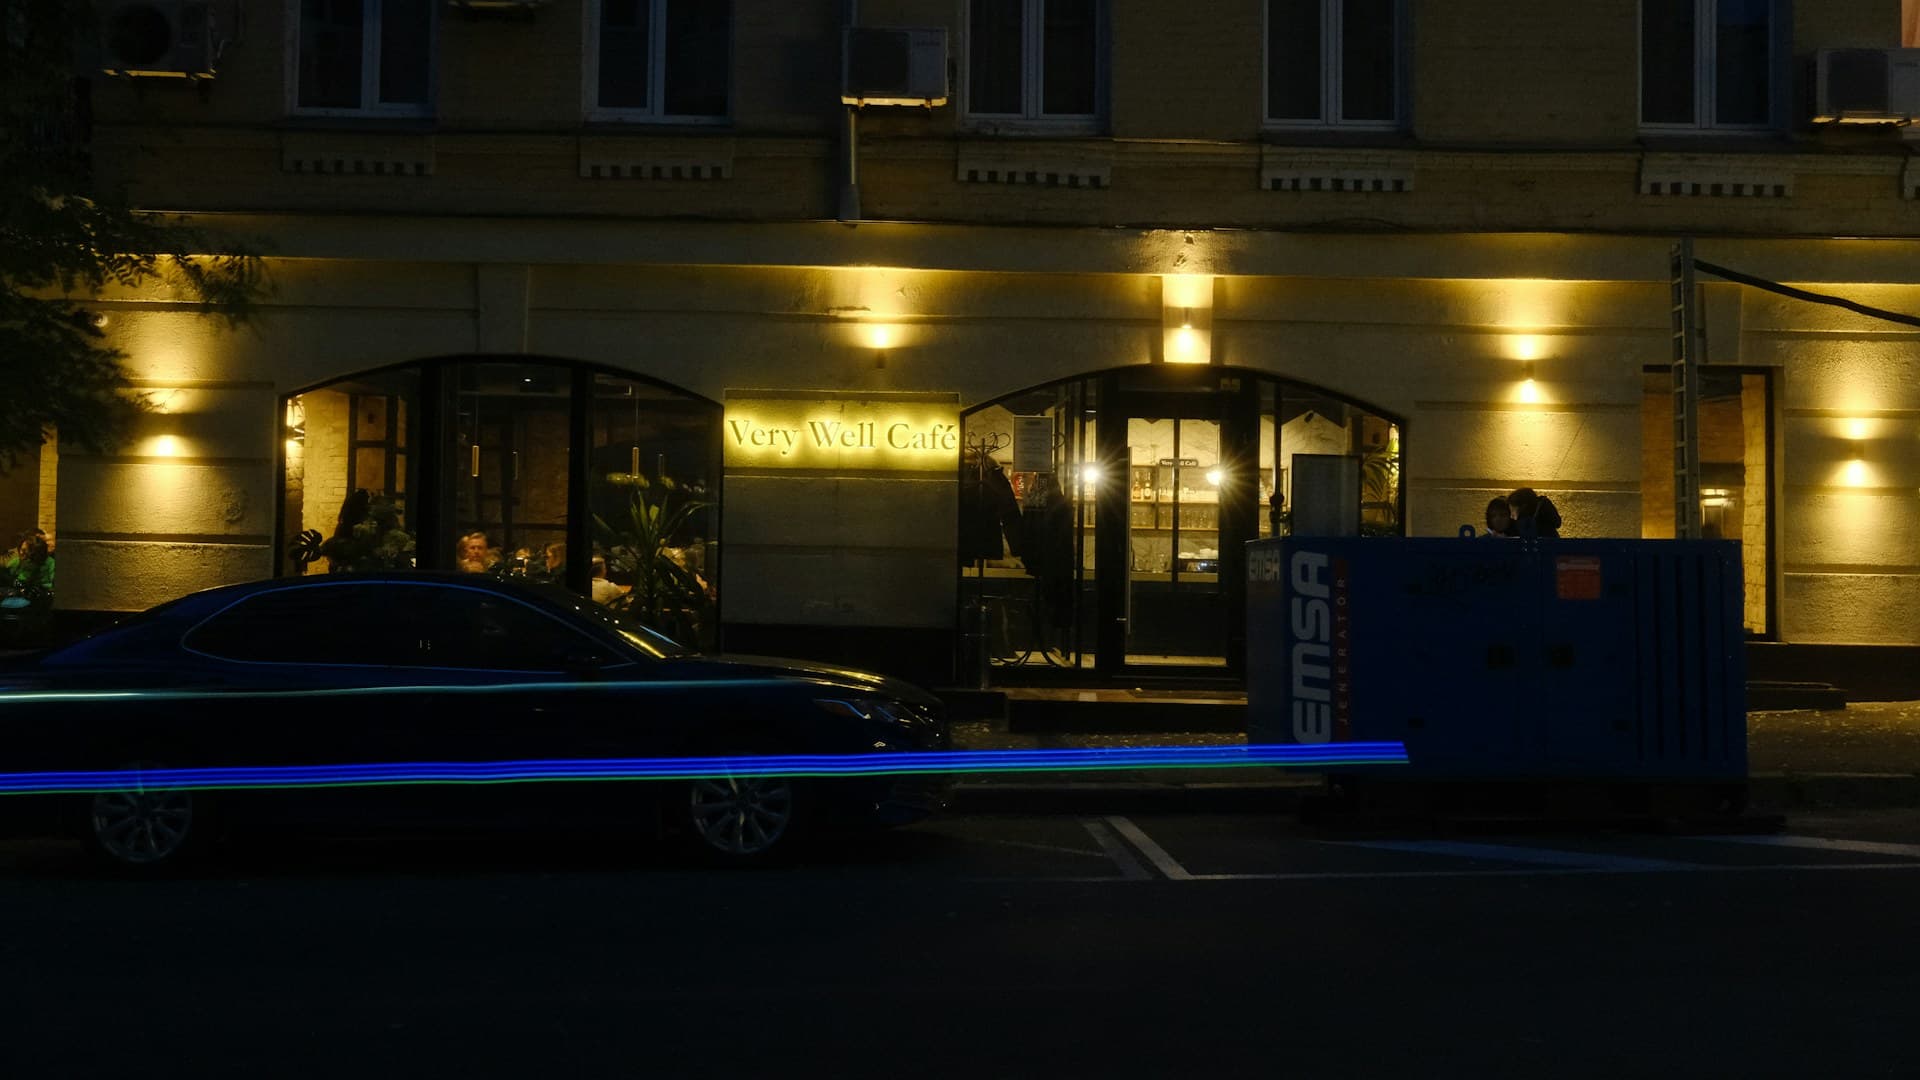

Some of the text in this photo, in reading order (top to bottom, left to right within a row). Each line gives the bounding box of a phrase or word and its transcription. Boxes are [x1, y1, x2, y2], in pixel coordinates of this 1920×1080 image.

[728, 420, 956, 455] Very Well Café
[1291, 549, 1331, 744] EMSA
[1336, 576, 1348, 727] JENERATOR
